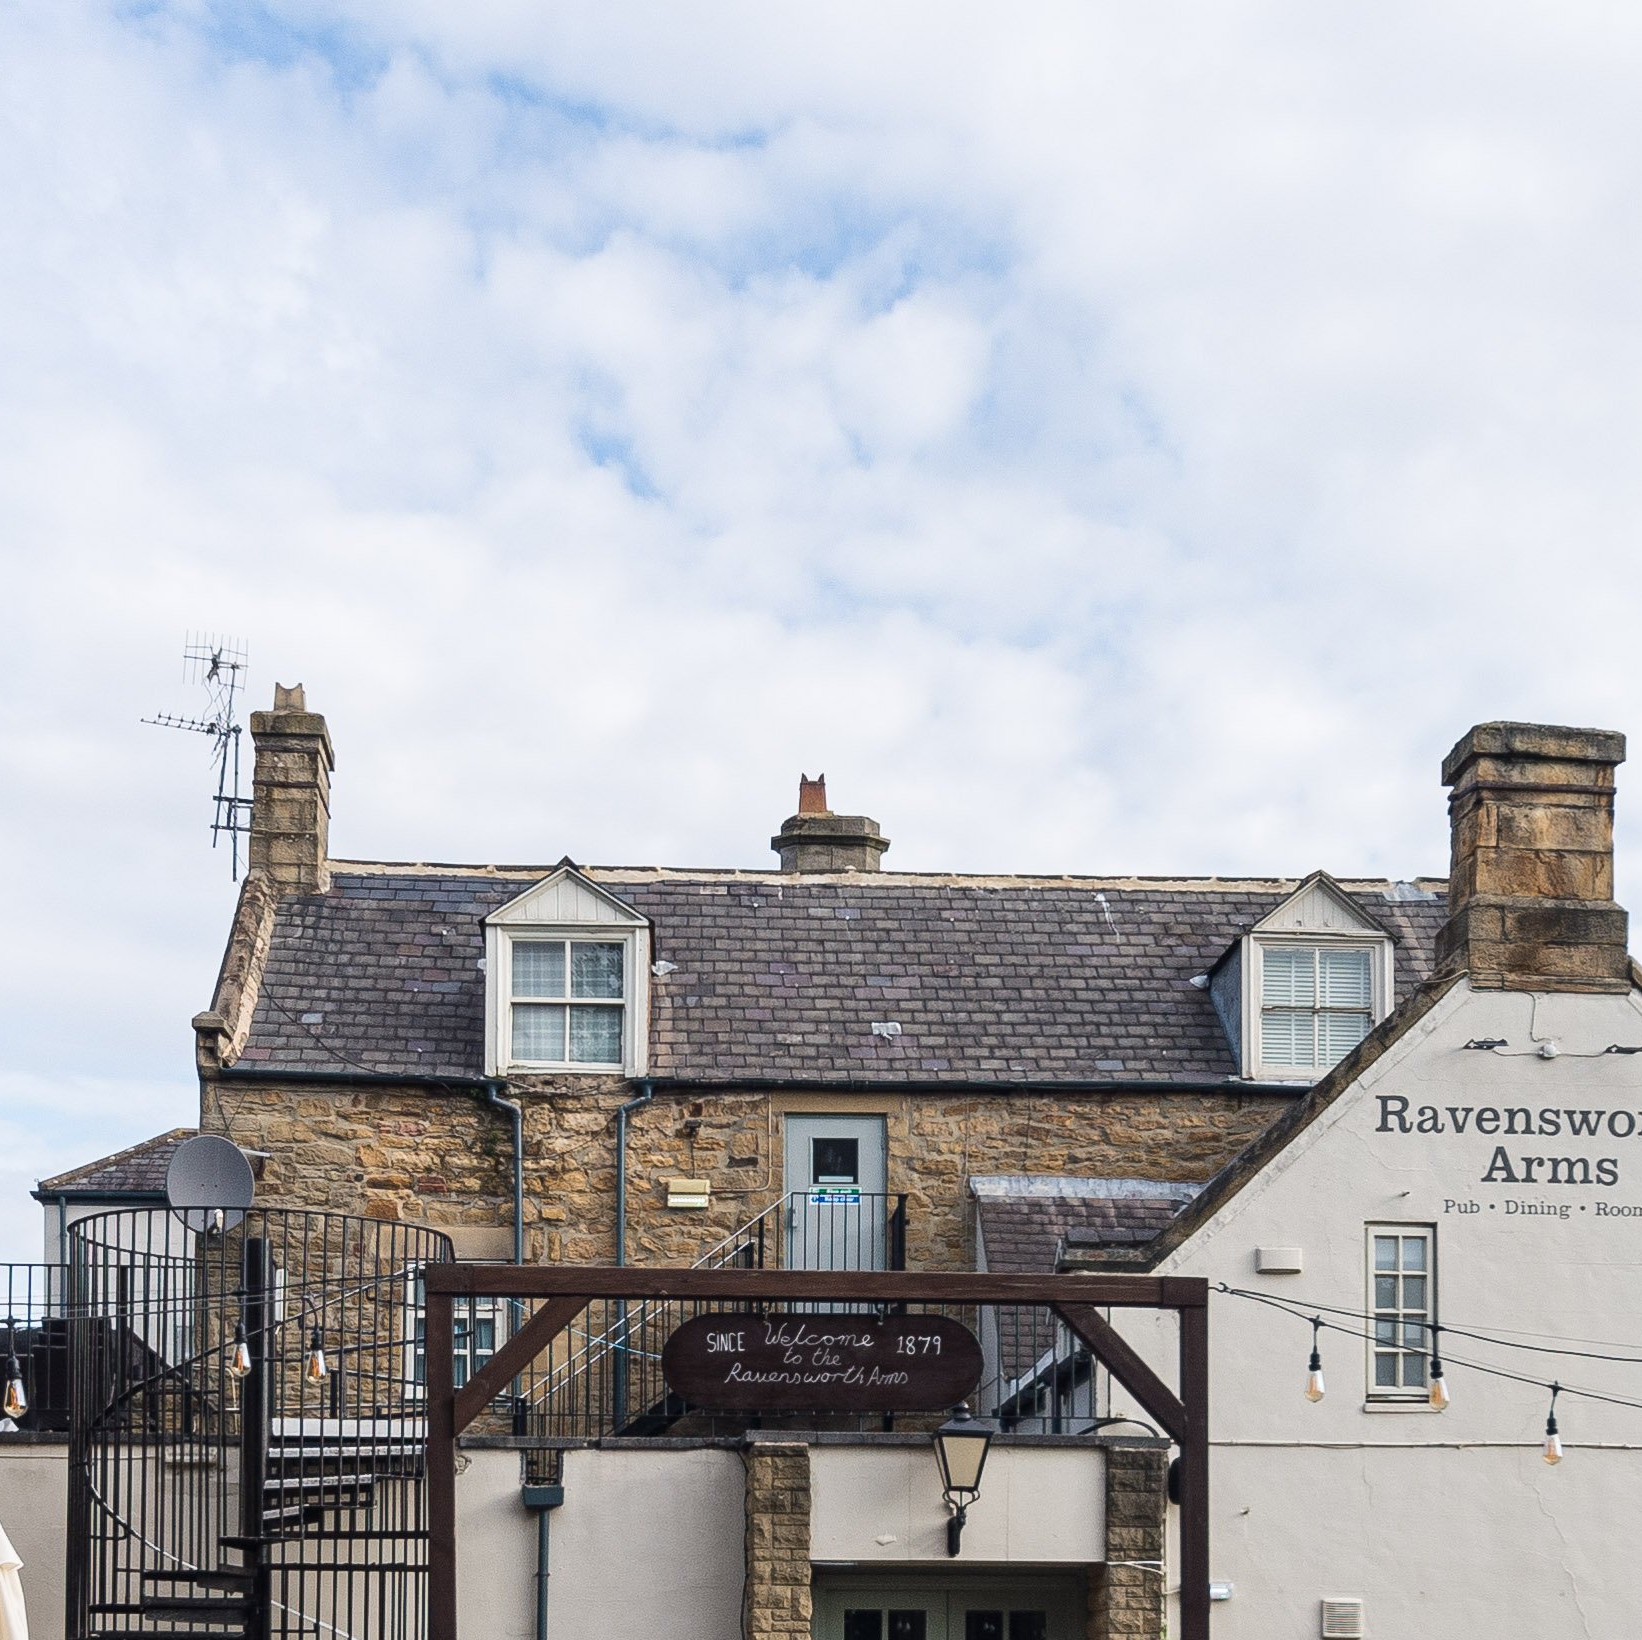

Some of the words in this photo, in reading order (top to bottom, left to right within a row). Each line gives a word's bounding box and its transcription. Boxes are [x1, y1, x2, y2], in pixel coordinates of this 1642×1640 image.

[1480, 1146, 1619, 1186] Arms
[1443, 1199, 1481, 1215] Pub
[1505, 1200, 1572, 1219] Dining
[707, 1332, 745, 1352] SINCE
[763, 1322, 874, 1347] Welcome
[896, 1336, 941, 1355] 1879
[783, 1347, 801, 1364] to
[812, 1348, 842, 1365] the
[724, 1362, 864, 1384] Ravensworth
[866, 1366, 908, 1386] Arms
